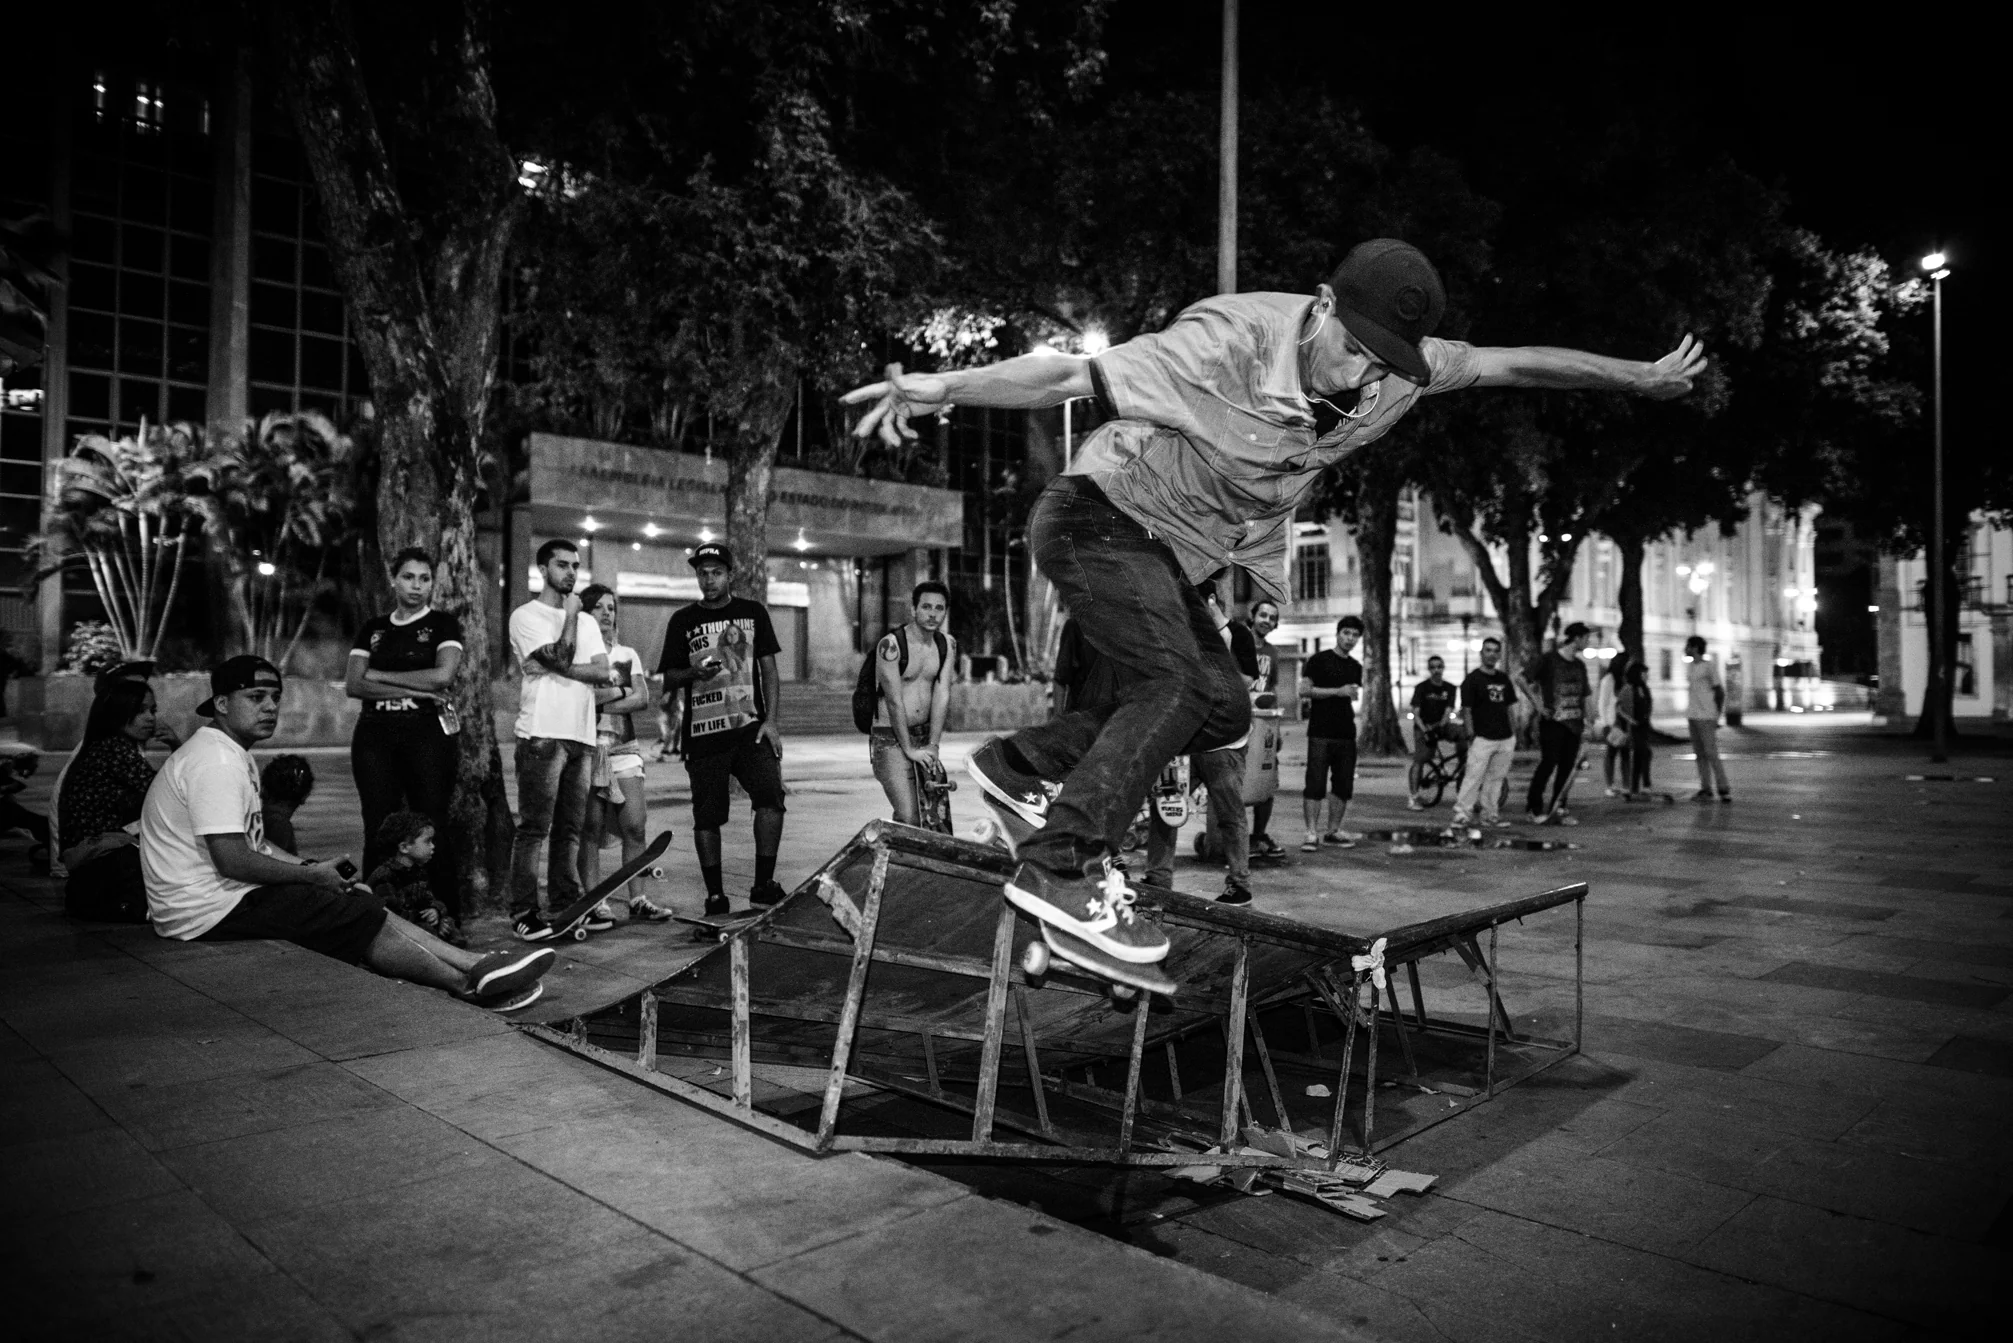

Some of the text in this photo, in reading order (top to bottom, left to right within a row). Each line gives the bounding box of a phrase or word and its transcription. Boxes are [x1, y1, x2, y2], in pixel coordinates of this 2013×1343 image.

[692, 691, 722, 707] FUCKED
[693, 718, 726, 734] MY LIFE
